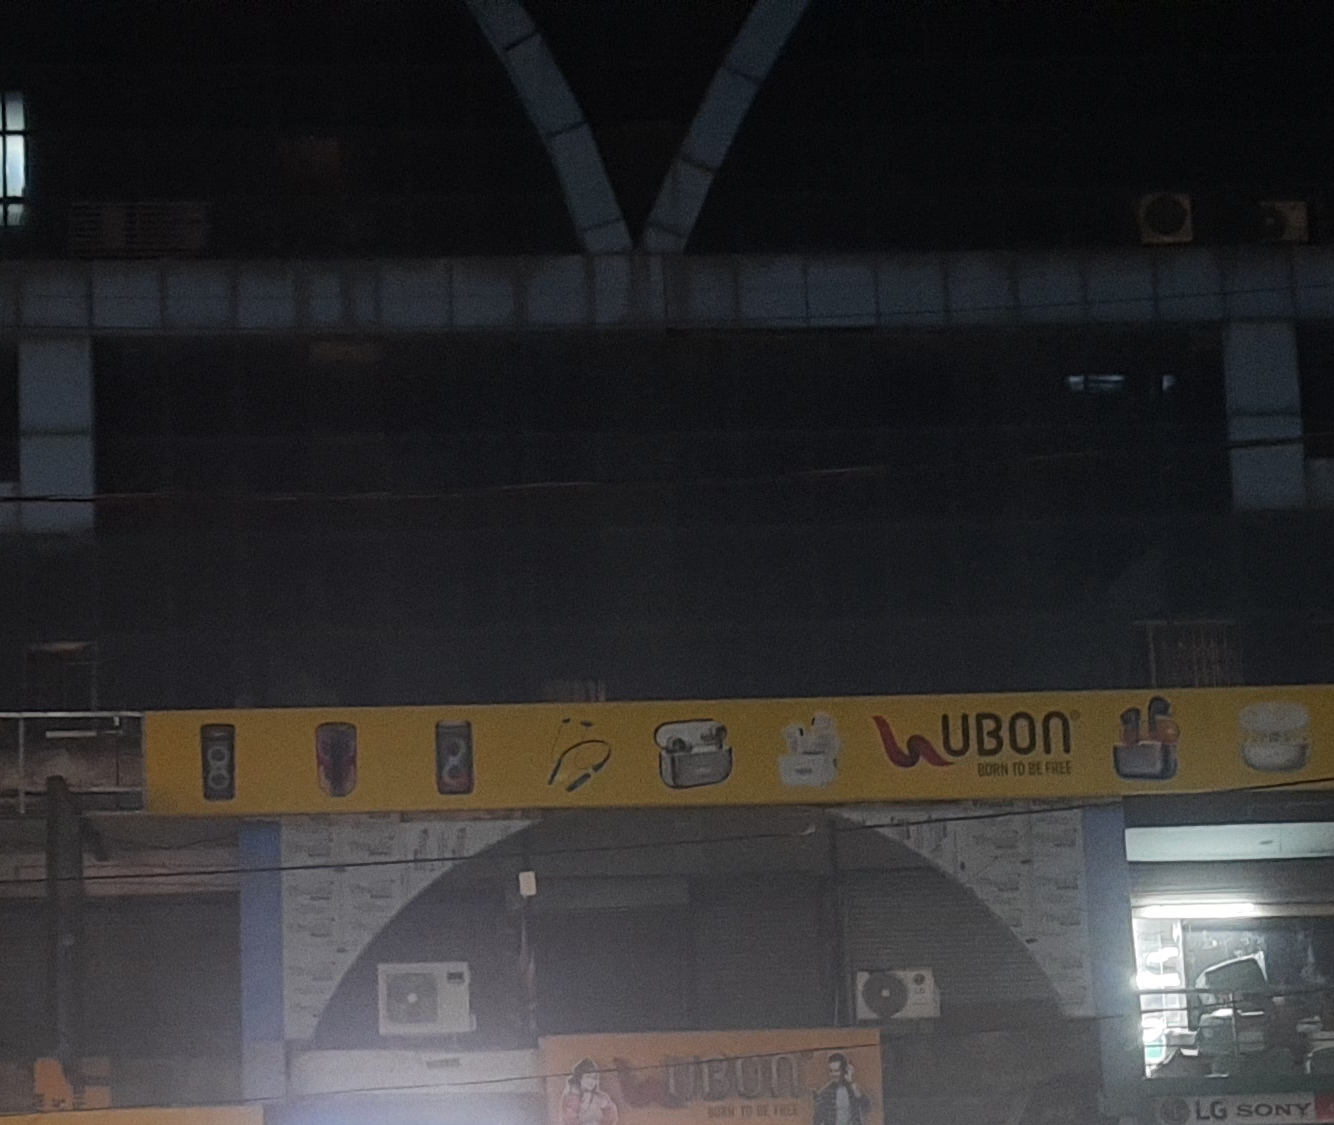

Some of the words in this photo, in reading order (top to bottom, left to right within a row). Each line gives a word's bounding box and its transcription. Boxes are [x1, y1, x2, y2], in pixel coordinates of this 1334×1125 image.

[941, 710, 1071, 757] UBON
[977, 762, 1009, 777] BORN
[1012, 761, 1026, 776] TO
[1028, 761, 1043, 776] BE
[1045, 760, 1072, 775] FREE
[740, 1104, 754, 1118] TO
[1195, 1100, 1228, 1121] LG
[1236, 1101, 1313, 1118] SONY
